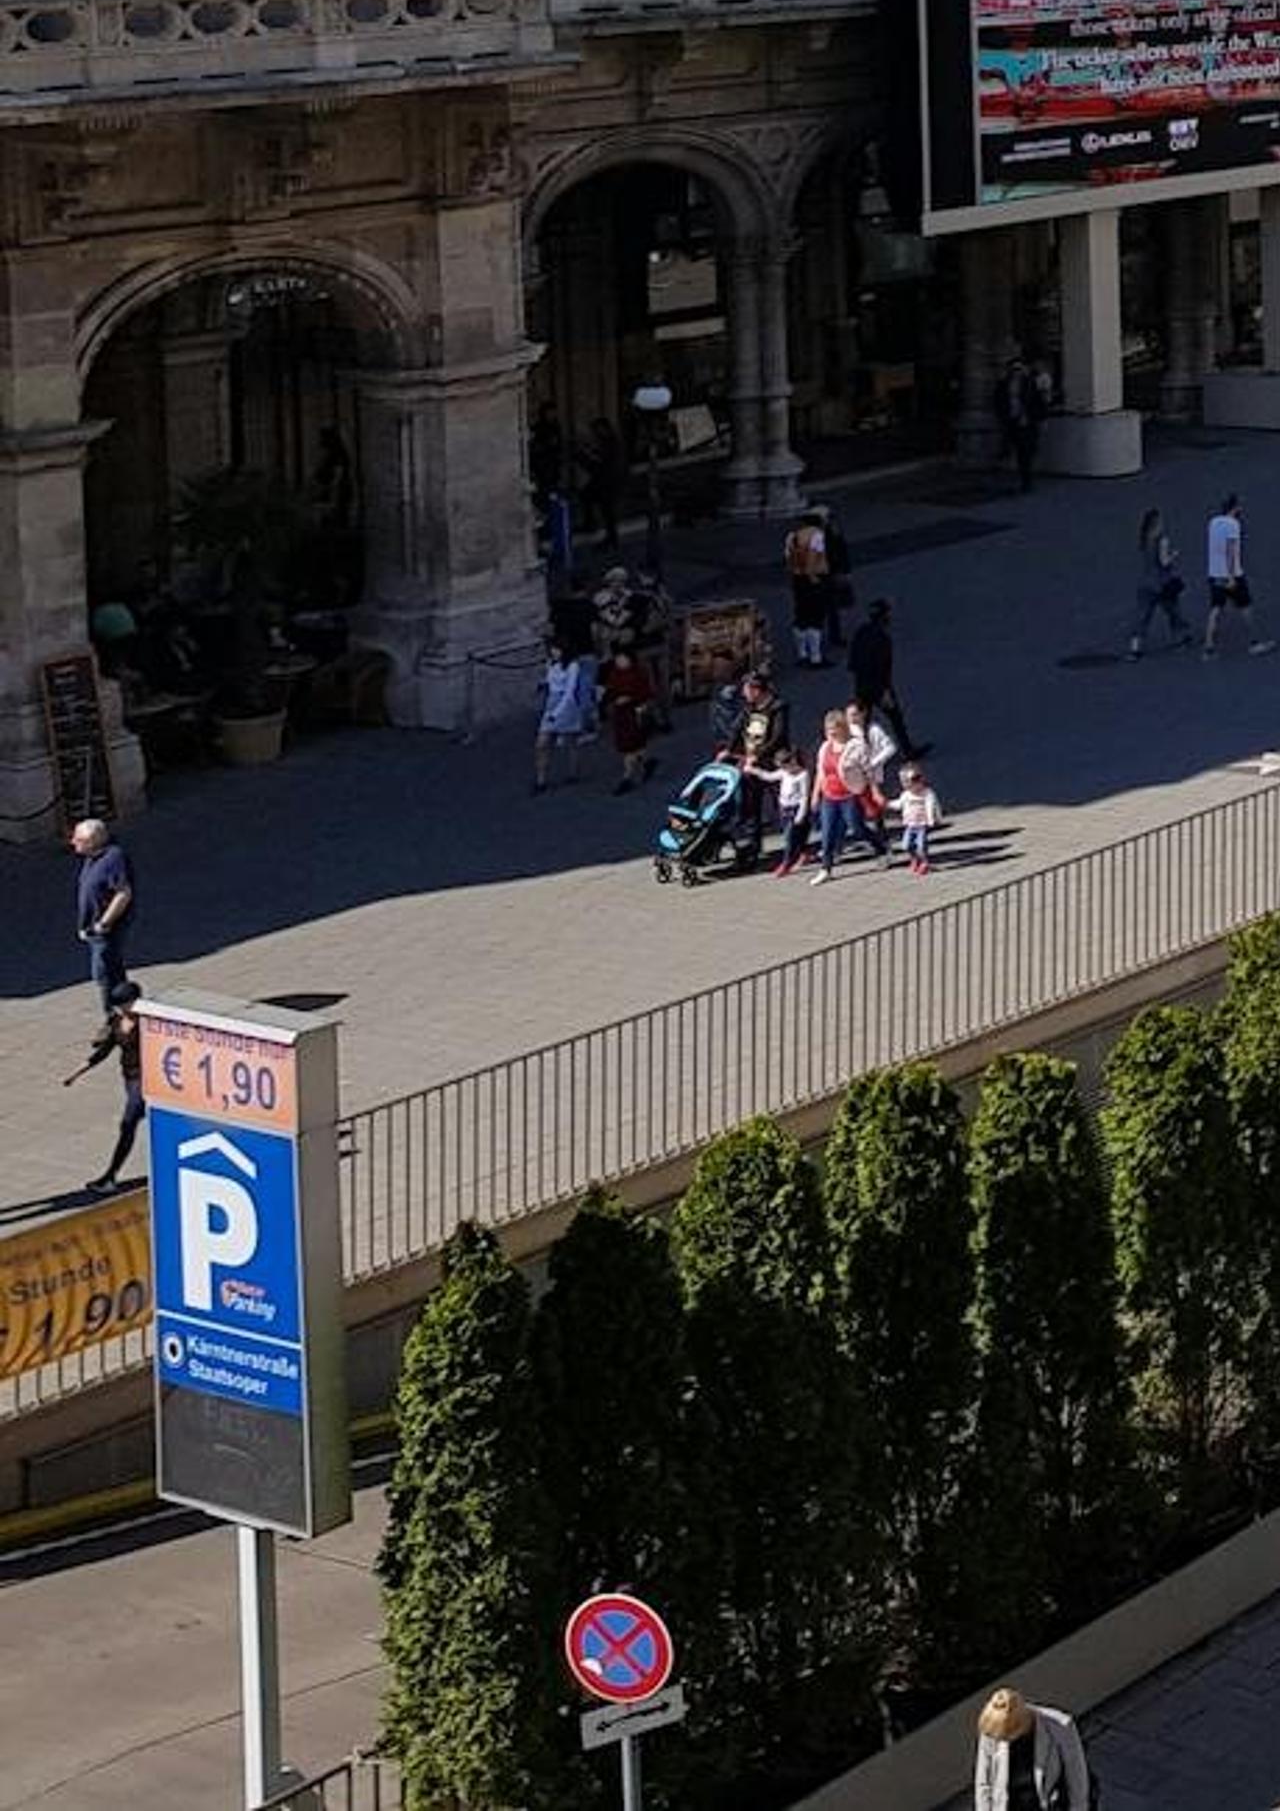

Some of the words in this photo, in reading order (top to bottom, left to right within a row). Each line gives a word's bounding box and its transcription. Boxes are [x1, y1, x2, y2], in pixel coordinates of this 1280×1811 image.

[197, 1052, 276, 1110] 1,90
[178, 1166, 259, 1311] P
[10, 1253, 111, 1304] Stunde
[186, 1335, 300, 1380] Kärntnerstraße
[187, 1358, 269, 1395] Staatsoper
